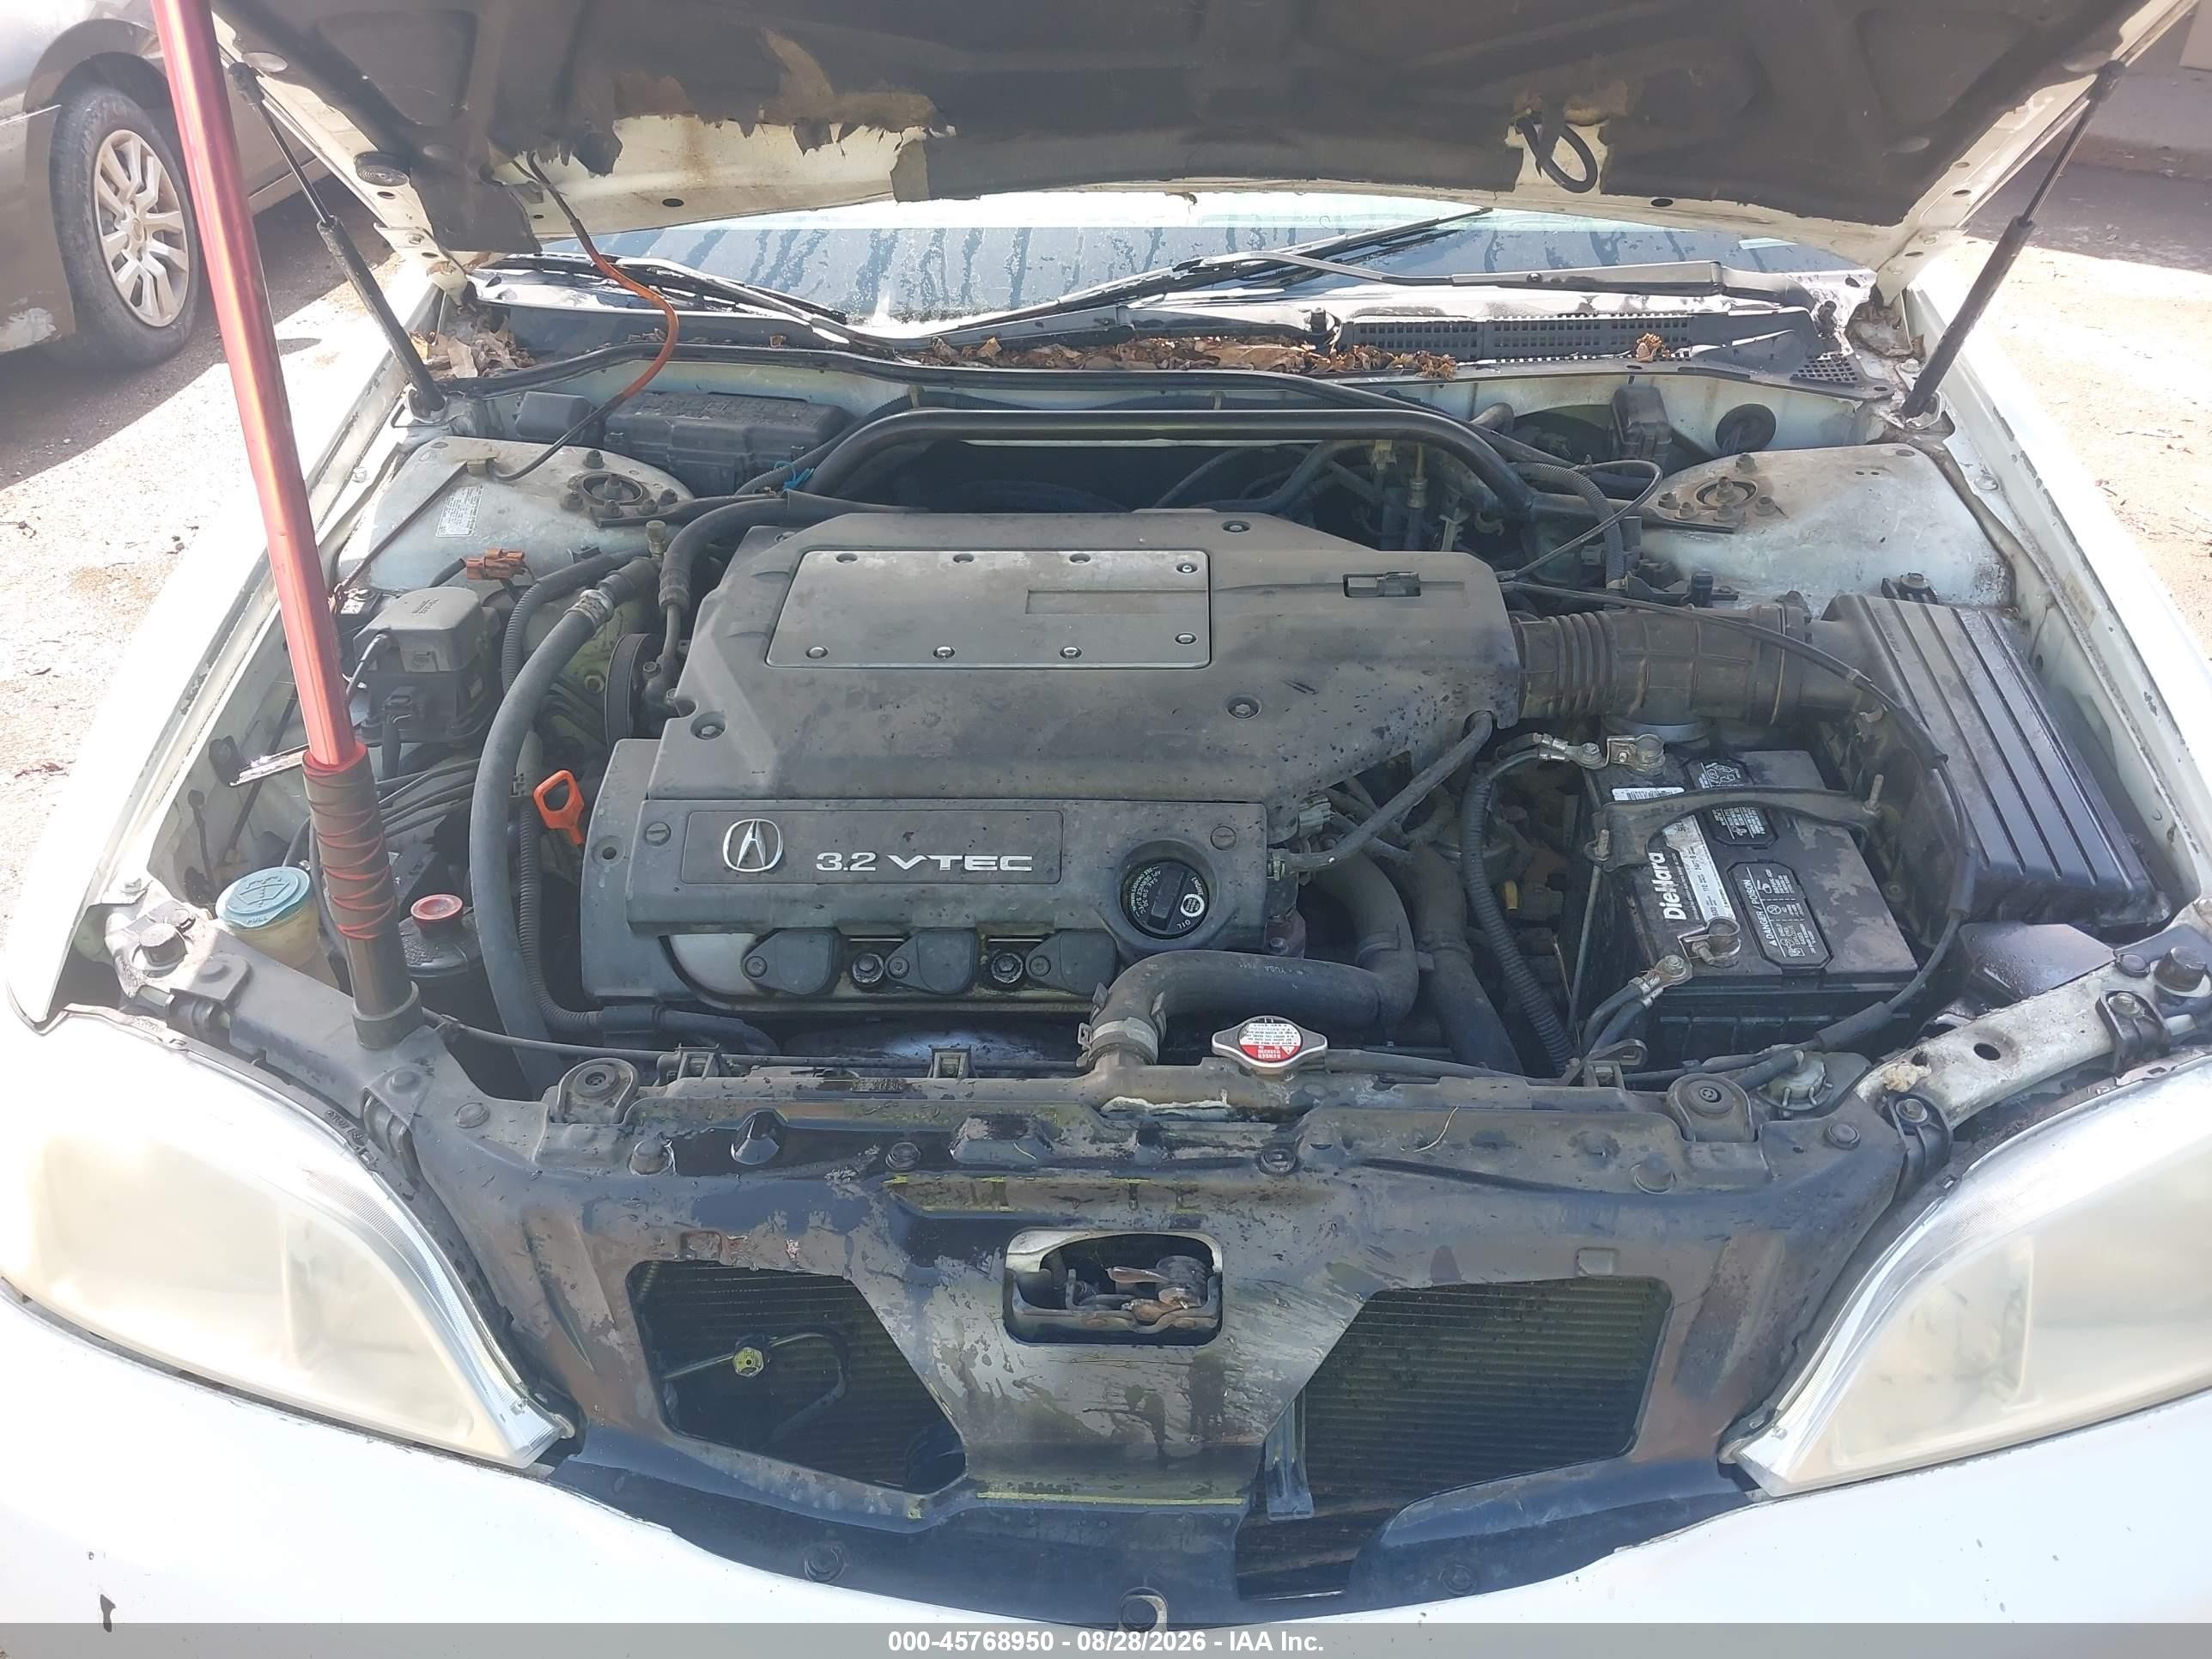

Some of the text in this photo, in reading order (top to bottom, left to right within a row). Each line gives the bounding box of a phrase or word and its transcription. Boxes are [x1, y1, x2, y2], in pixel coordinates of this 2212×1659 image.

[816, 851, 1033, 872] 3.2 VTEC
[1137, 875, 1152, 896] SERVICE
[1191, 876, 1204, 896] ENGINE
[1741, 879, 1759, 905] POISON
[1176, 920, 1191, 929] OIL
[1756, 911, 1777, 940] DANGER
